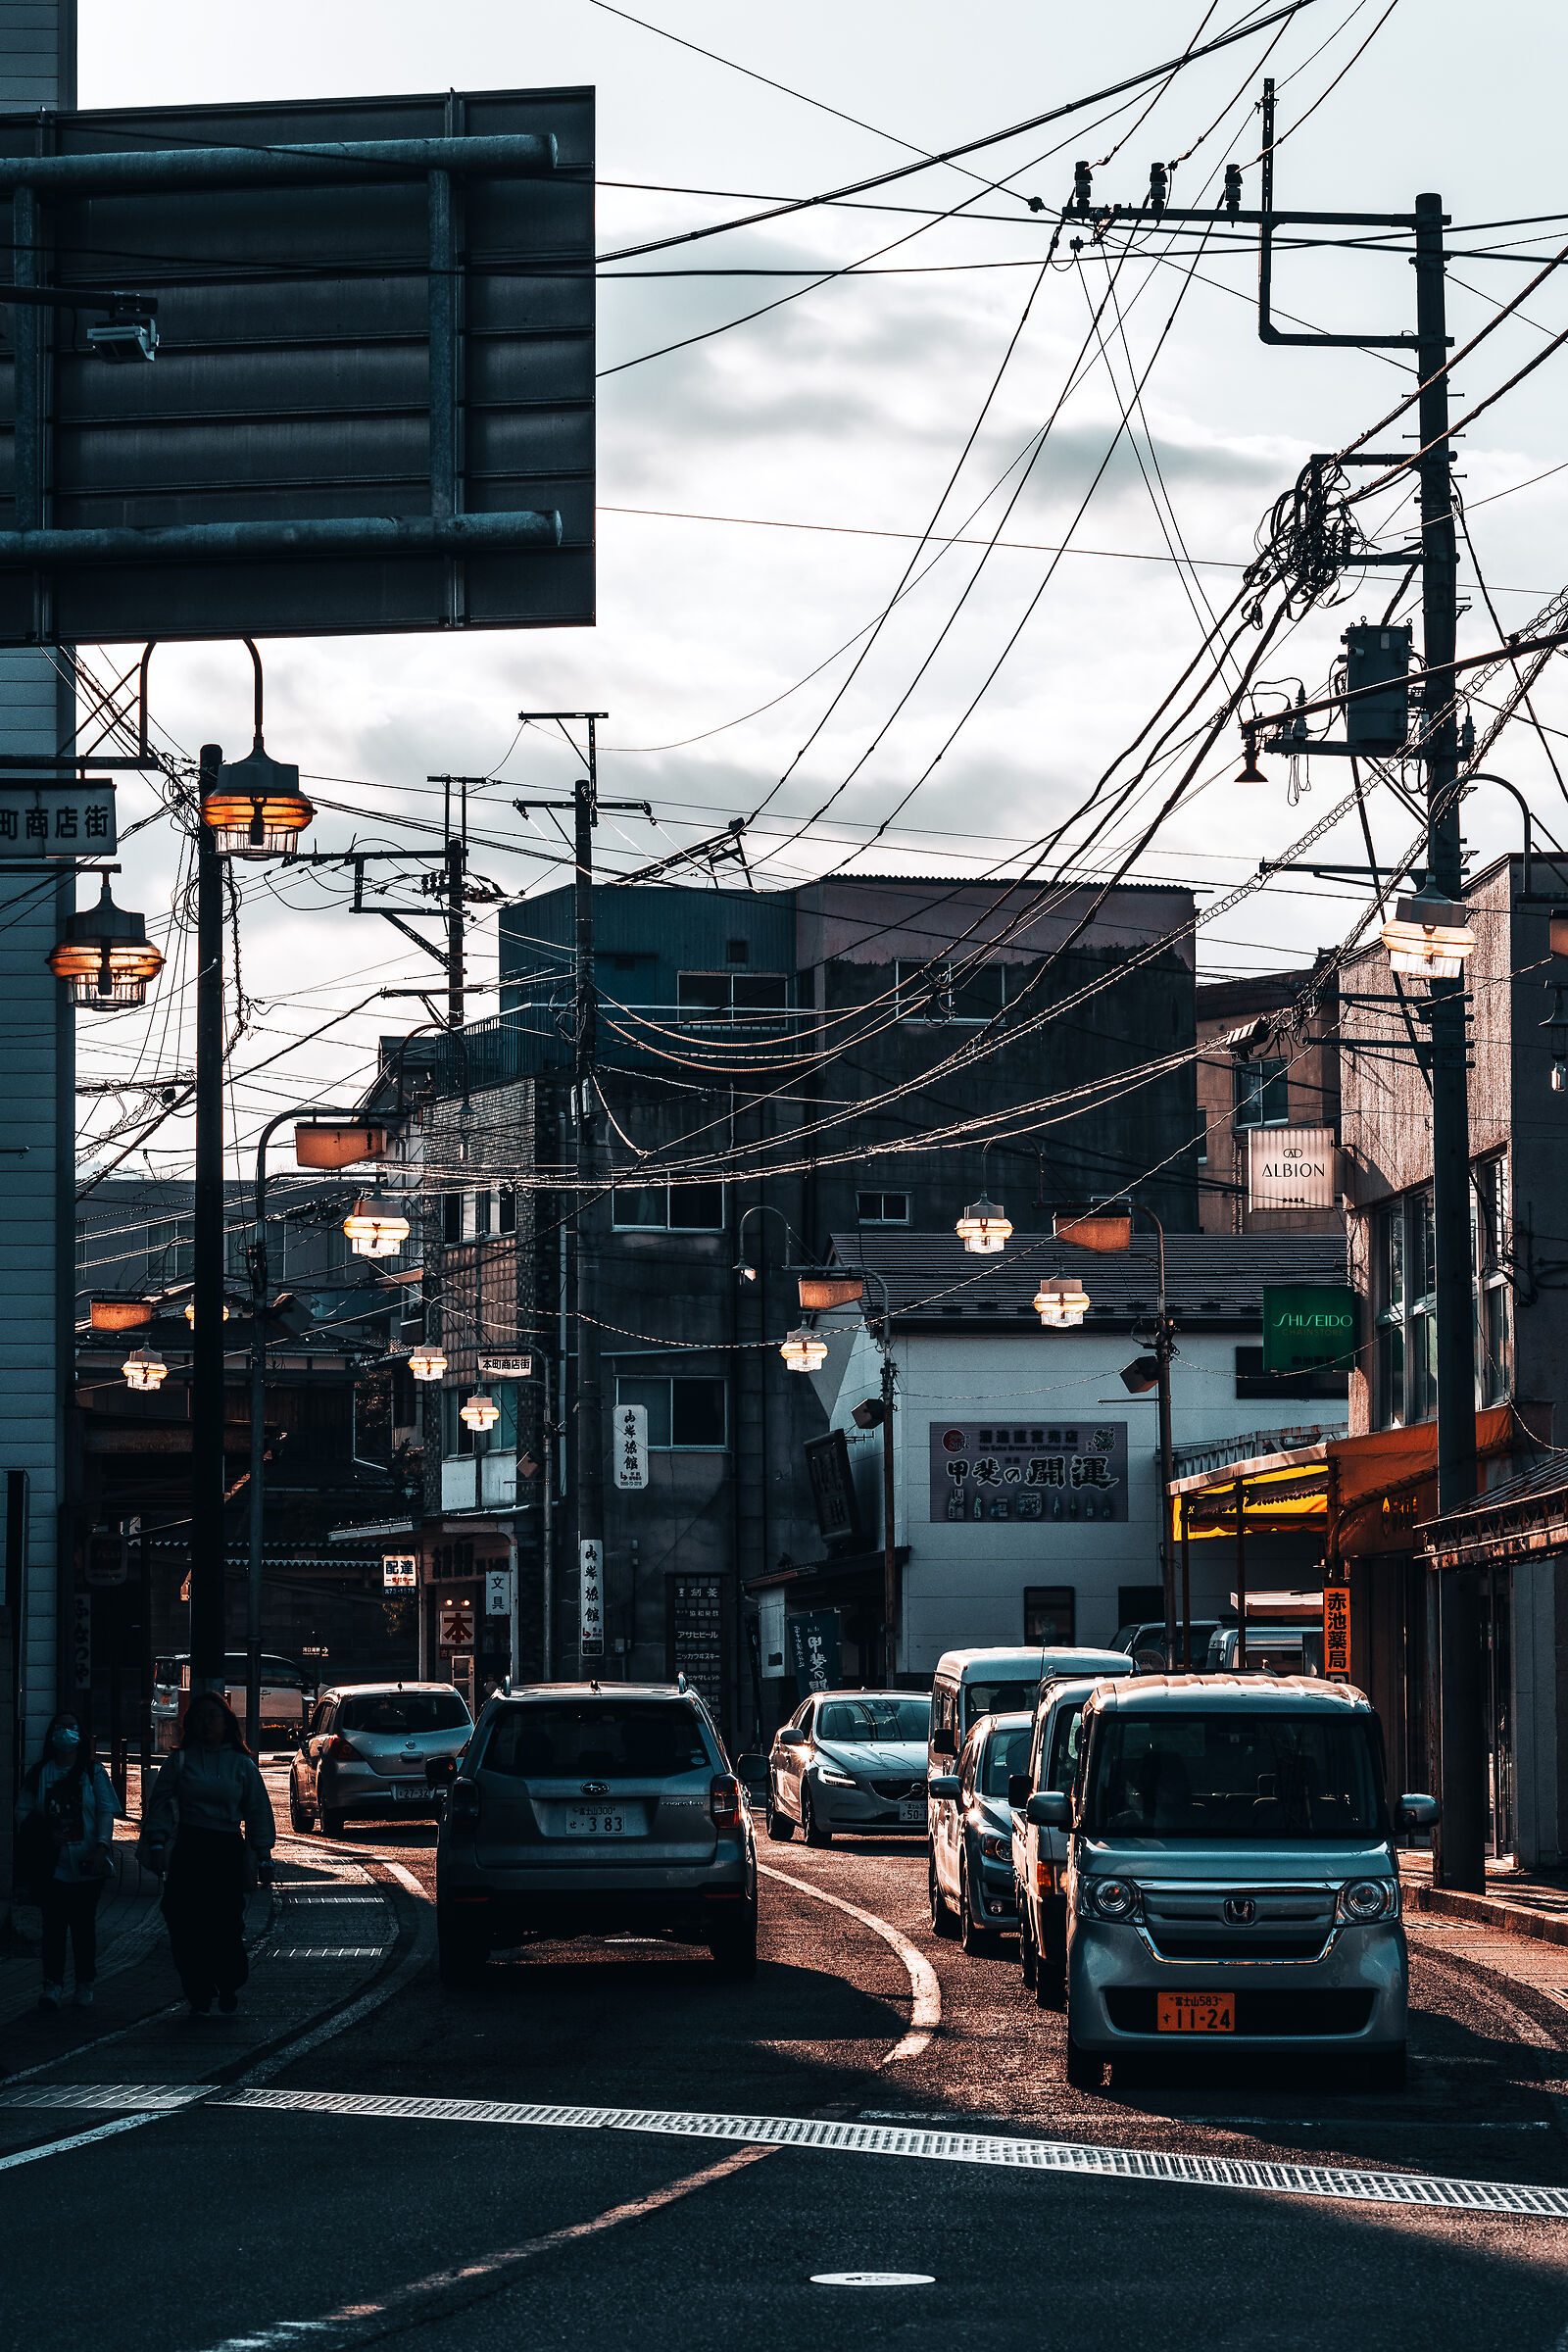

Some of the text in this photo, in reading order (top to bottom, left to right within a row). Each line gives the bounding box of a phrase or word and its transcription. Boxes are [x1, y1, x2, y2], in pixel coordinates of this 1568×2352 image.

[0, 806, 108, 840] 町商店街
[1262, 1163, 1325, 1177] ALBION
[1272, 1313, 1353, 1327] SHISEIDO
[482, 1358, 530, 1370] 本町商店街
[623, 1409, 638, 1470] 山岸旅館
[947, 1455, 1119, 1490] 甲斐の開運
[385, 1560, 414, 1575] 配達
[491, 1576, 505, 1610] 文具
[584, 1544, 600, 1623] 山岸旅館
[443, 1613, 473, 1643] 本
[1327, 1592, 1348, 1669] 赤池薬局
[1175, 1996, 1219, 2006] 富士山583
[1178, 2008, 1231, 2029] 11-24
